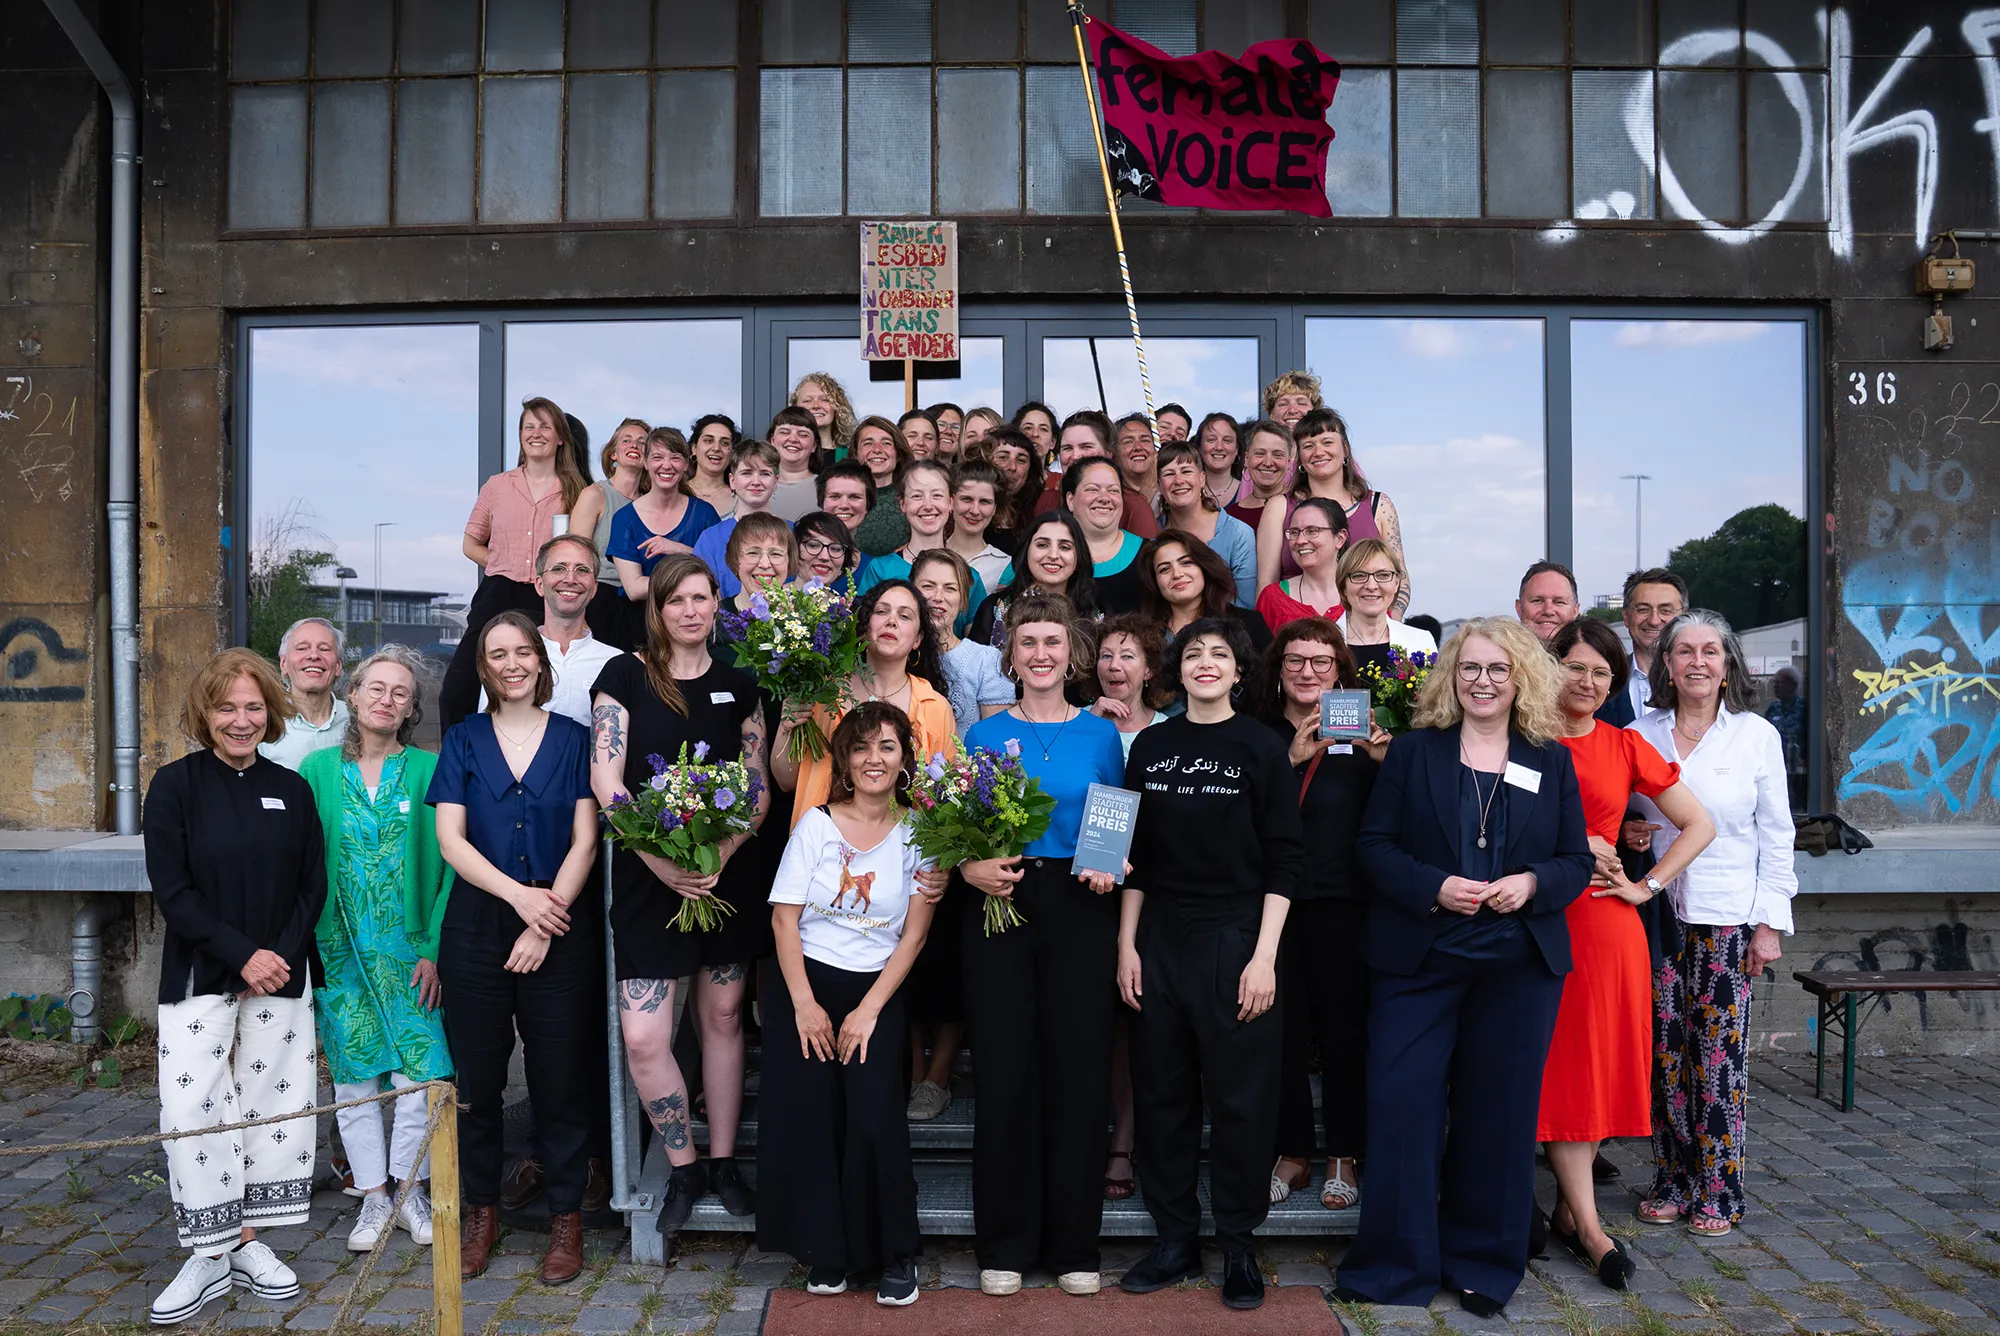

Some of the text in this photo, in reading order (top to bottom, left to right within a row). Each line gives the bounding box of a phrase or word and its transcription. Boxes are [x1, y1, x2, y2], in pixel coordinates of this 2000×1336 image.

[862, 309, 941, 334] TRANS
[863, 332, 957, 359] AGENDER
[1848, 371, 1897, 405] 36
[1888, 453, 1975, 505] NO
[1330, 716, 1359, 725] PREIS
[1146, 756, 1241, 778] زن زندگی آزادی
[1094, 791, 1133, 804] HAMBURGER
[1177, 786, 1195, 794] LIFE
[1201, 785, 1240, 794] FREEDOM
[1090, 805, 1129, 821] KULTUR
[1092, 797, 1131, 812] STADTTEIL
[1088, 814, 1128, 832] PREIS
[1085, 830, 1101, 838] 2024
